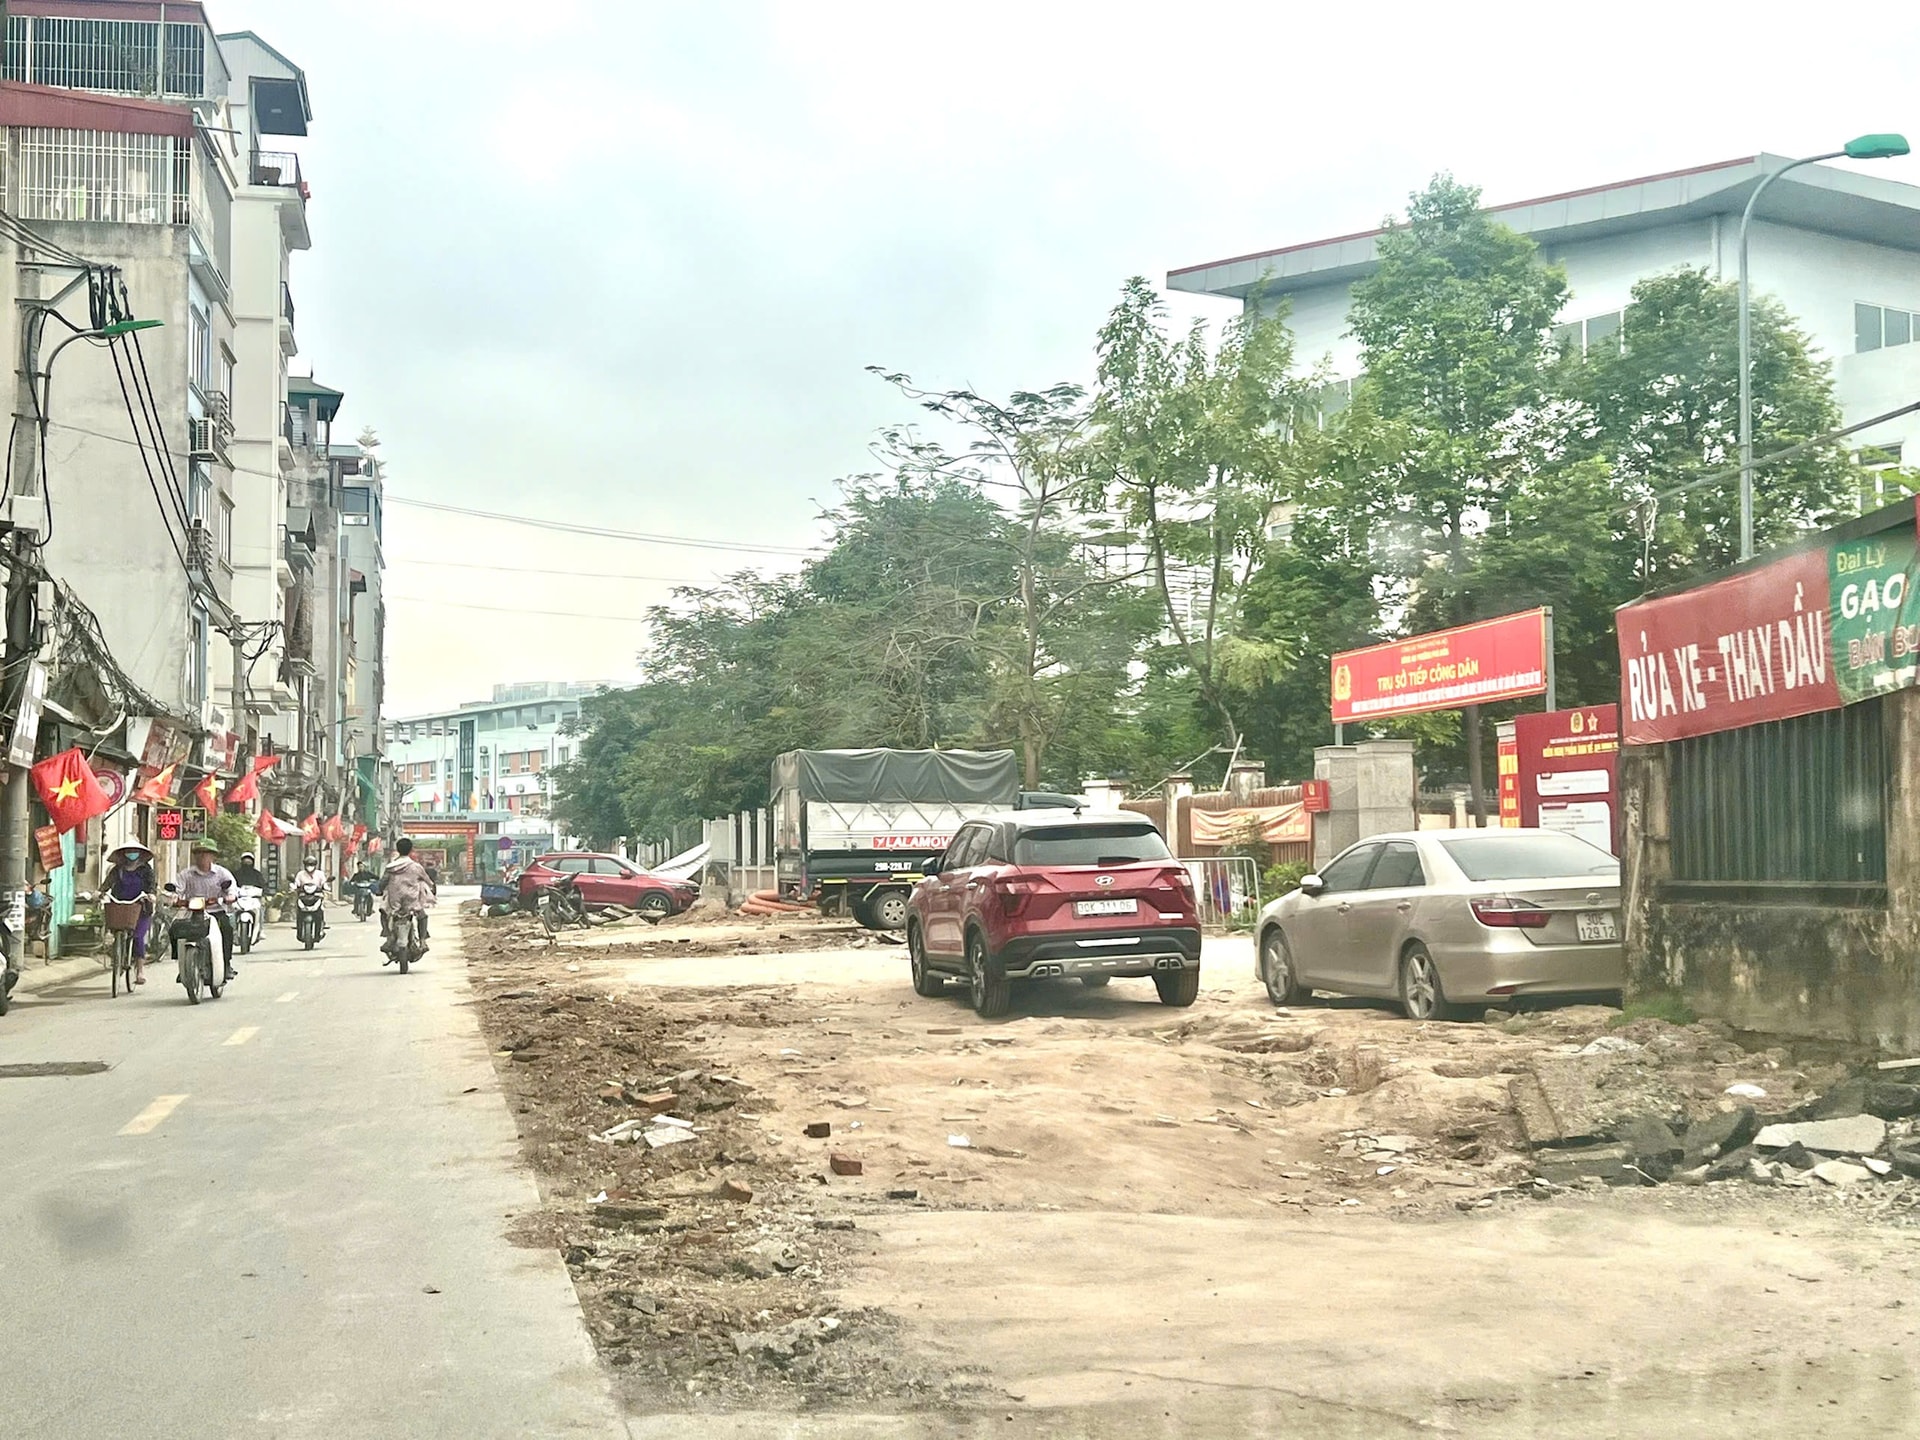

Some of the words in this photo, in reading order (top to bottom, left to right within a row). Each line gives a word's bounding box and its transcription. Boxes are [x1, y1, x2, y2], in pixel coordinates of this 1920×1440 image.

[1841, 573, 1907, 622] GẠO
[1628, 631, 1677, 722] RỬA
[1674, 643, 1707, 713] XE
[1718, 624, 1774, 703] THAY
[1778, 581, 1825, 690] DẦU
[1377, 676, 1393, 694] TRỤ
[1408, 664, 1428, 686] TIẾP
[1430, 663, 1456, 683] CÔNG
[1458, 657, 1478, 678] DÂN
[886, 836, 953, 848] LALAMOV
